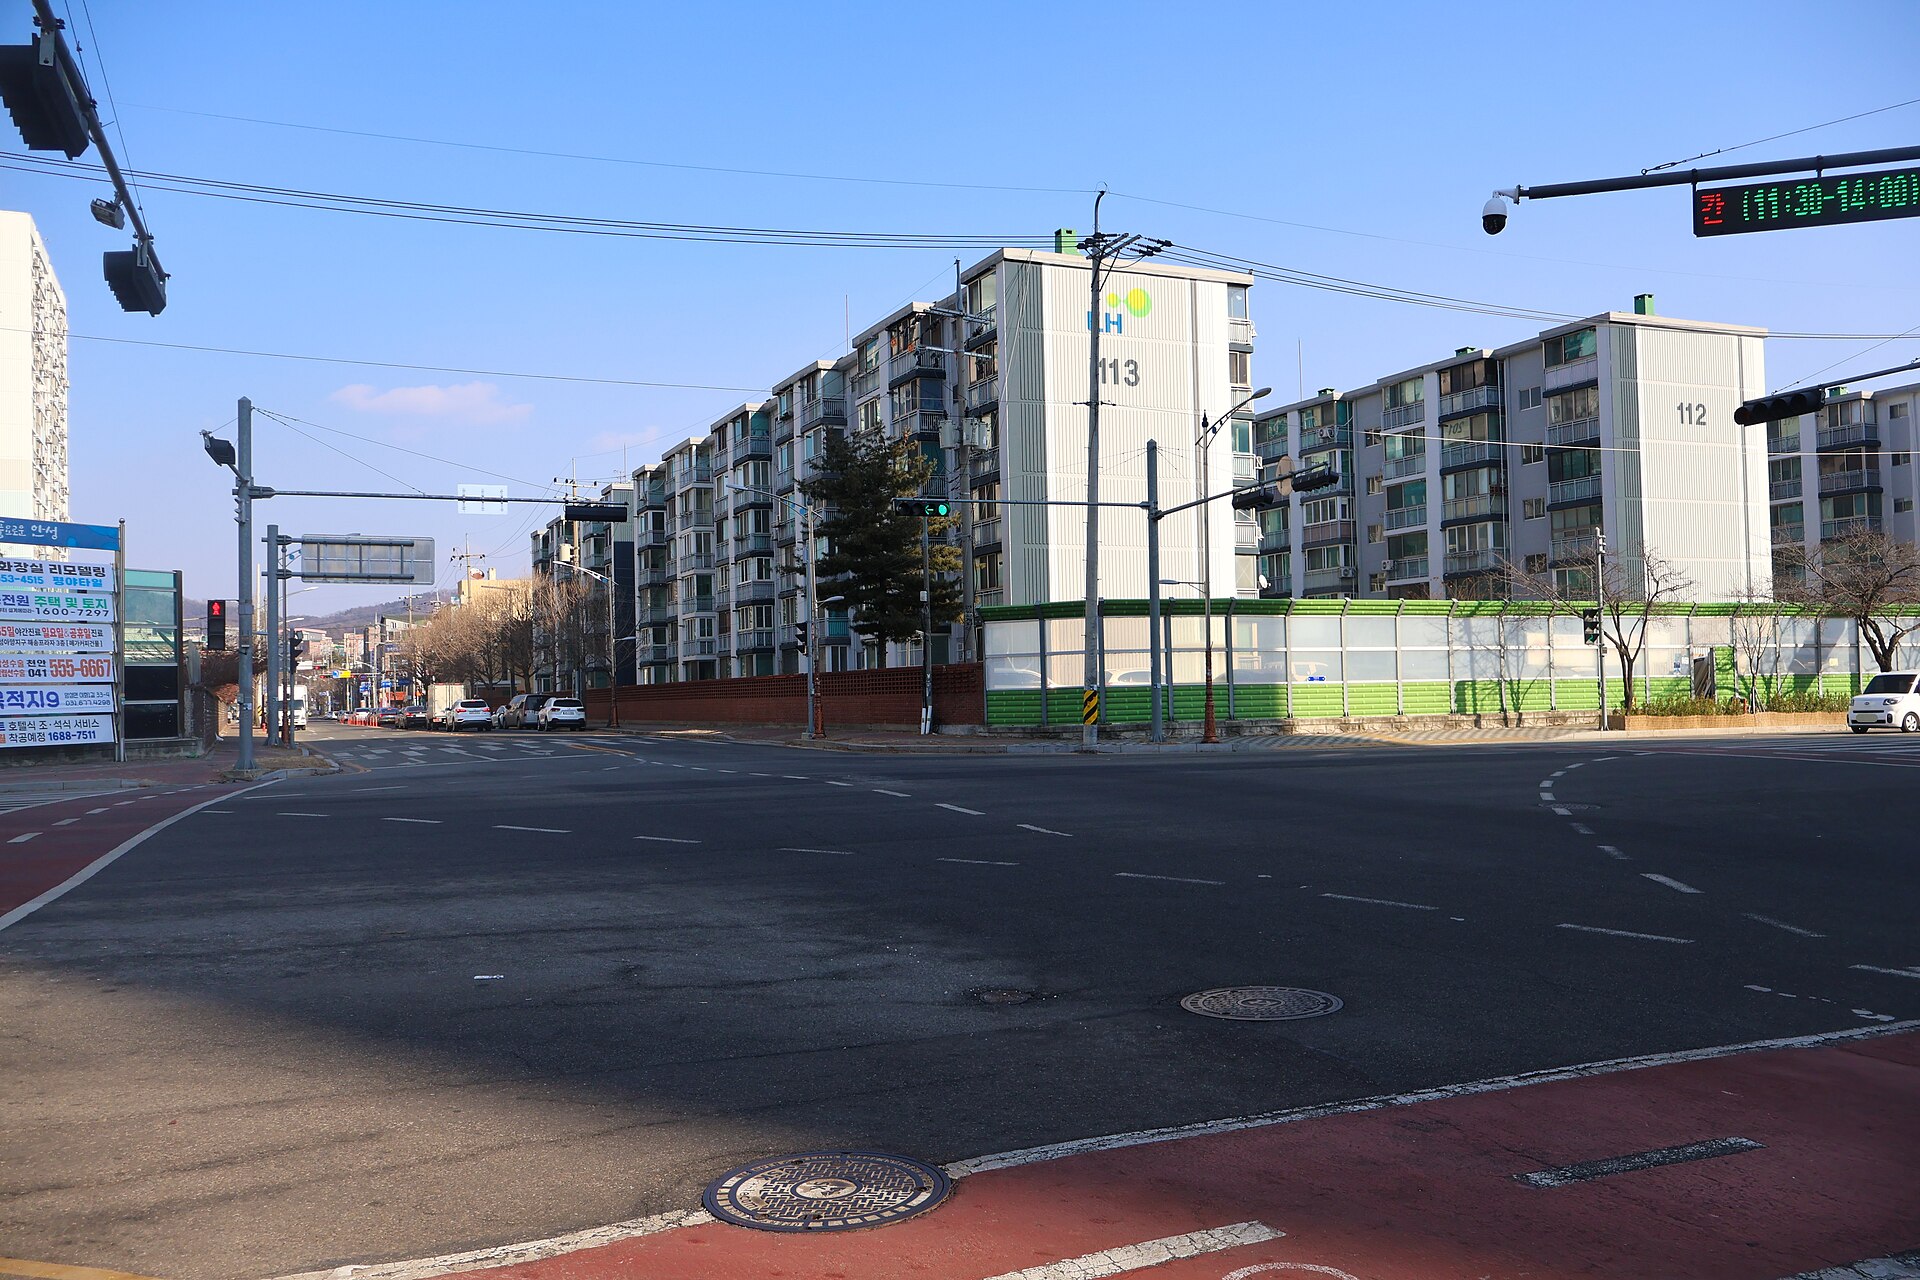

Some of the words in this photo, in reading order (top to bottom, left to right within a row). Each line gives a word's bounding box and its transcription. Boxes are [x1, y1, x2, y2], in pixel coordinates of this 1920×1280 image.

[1099, 357, 1140, 387] 113
[1677, 402, 1706, 425] 112
[31, 524, 58, 540] 안성
[0, 561, 44, 574] 화장실
[48, 564, 106, 578] 리모델링
[0, 594, 30, 607] 전원
[34, 595, 61, 608] 주택
[65, 597, 78, 608] 및
[82, 598, 107, 609] 토지
[36, 607, 109, 617] 1600-7297
[0, 659, 24, 668] 성수술
[26, 659, 46, 668] 천안
[49, 658, 111, 678] 555-6667
[28, 668, 47, 678] 041
[0, 690, 60, 710] 적지9
[9, 721, 36, 732] 호텔식
[74, 718, 100, 729] 서비스
[9, 733, 46, 743] 착공예정
[48, 730, 97, 741] 1688-7511
